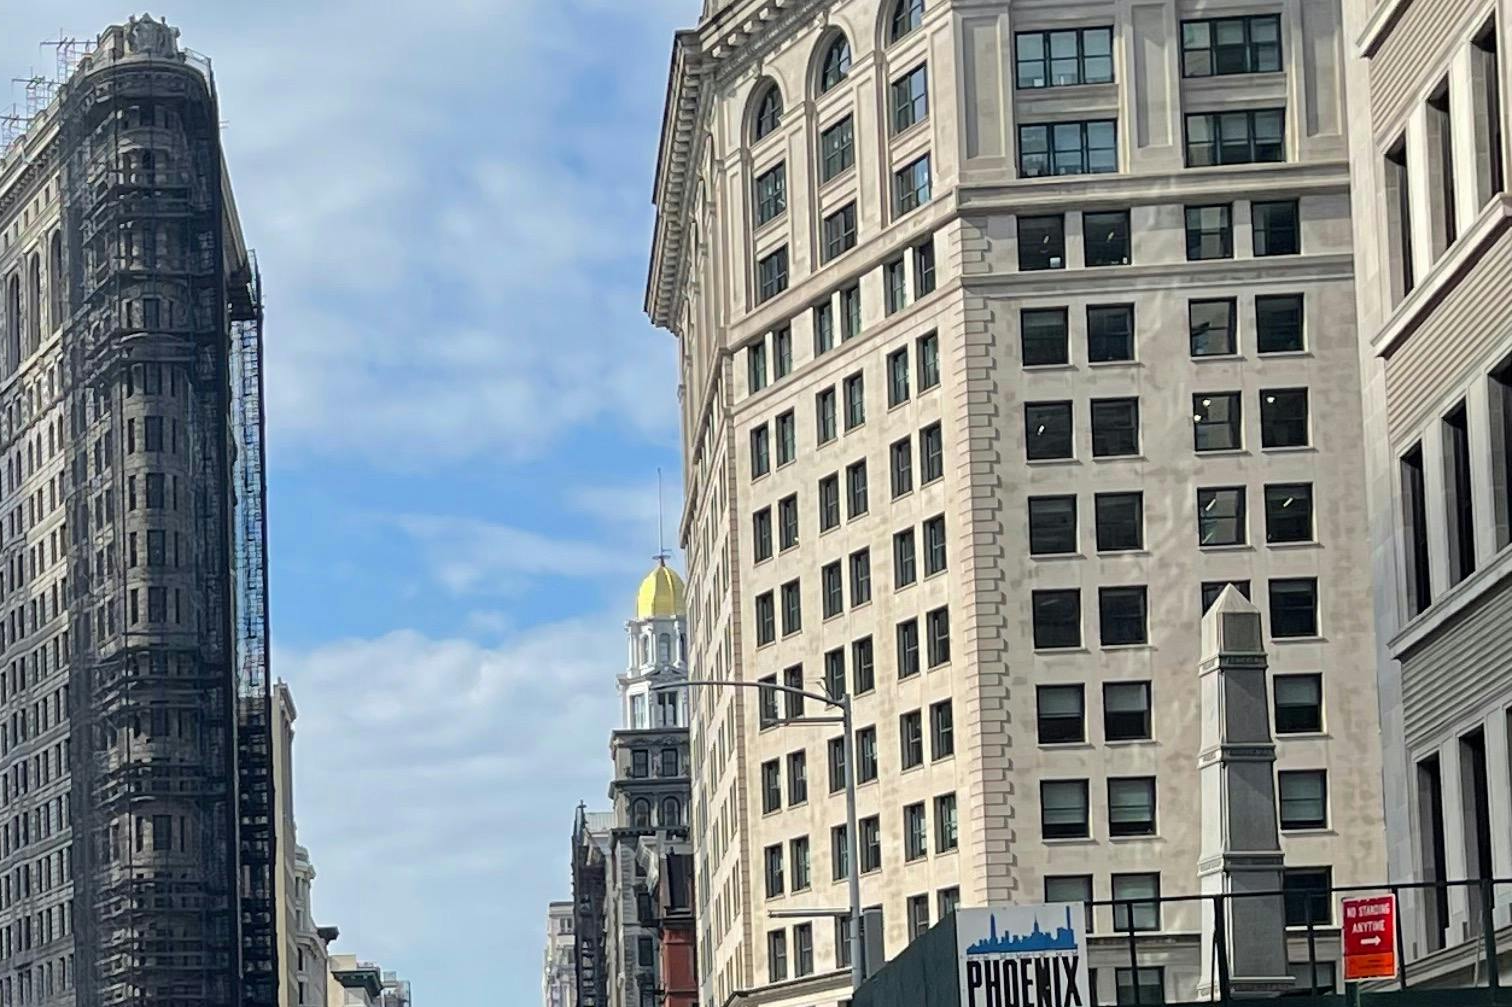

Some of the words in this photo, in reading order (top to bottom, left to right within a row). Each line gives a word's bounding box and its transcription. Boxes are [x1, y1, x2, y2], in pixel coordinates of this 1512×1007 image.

[1346, 906, 1356, 918] NO
[1358, 902, 1391, 918] STANDING
[1351, 919, 1385, 934] ANYTIME
